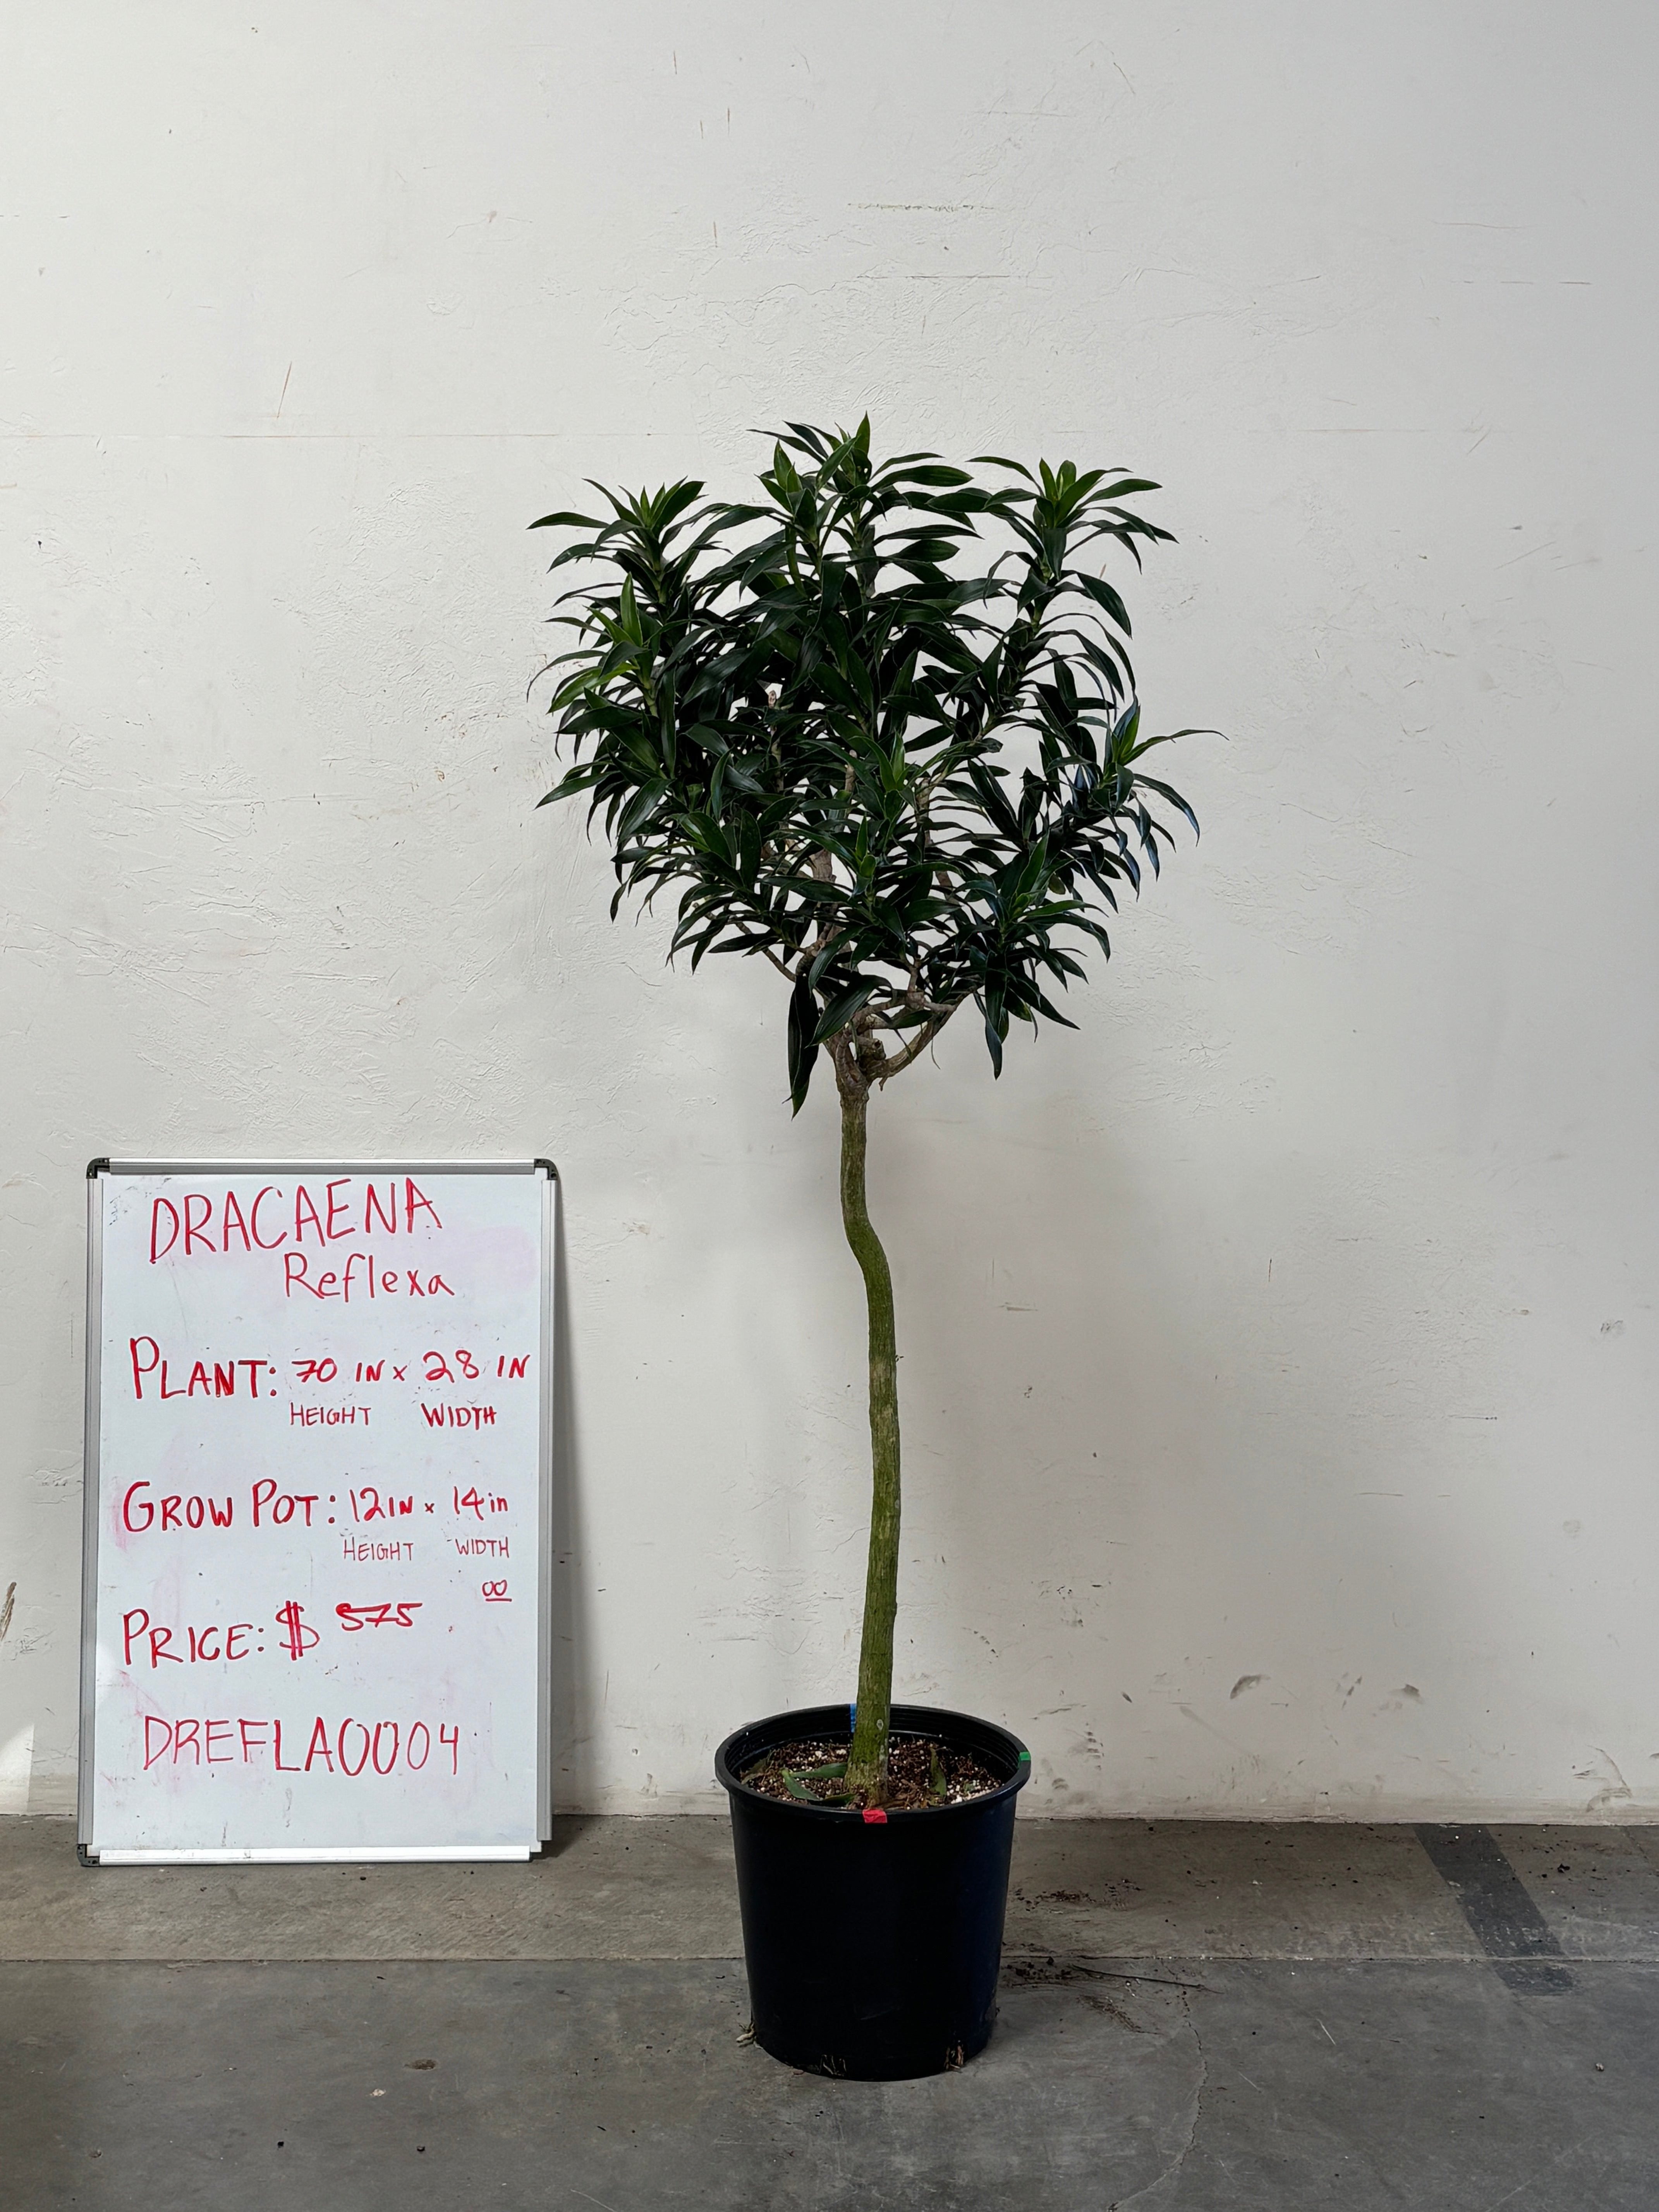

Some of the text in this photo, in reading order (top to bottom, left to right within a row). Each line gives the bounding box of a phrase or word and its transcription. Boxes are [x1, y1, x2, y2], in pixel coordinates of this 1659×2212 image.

[149, 1178, 443, 1265] DRACAENA
[283, 1252, 454, 1302] Reflexa
[129, 1336, 277, 1400] PLANT:
[291, 1358, 338, 1383] 70
[356, 1359, 385, 1382] IN
[422, 1349, 479, 1382] 28
[497, 1354, 530, 1379] IN
[290, 1403, 497, 1431] HEIGHT WIDTH
[122, 1481, 233, 1533] GROW
[252, 1479, 335, 1527] POT:
[343, 1537, 509, 1561] HEIGHT WIDTH
[122, 1609, 263, 1668] PRICE:
[335, 1602, 423, 1632] 575
